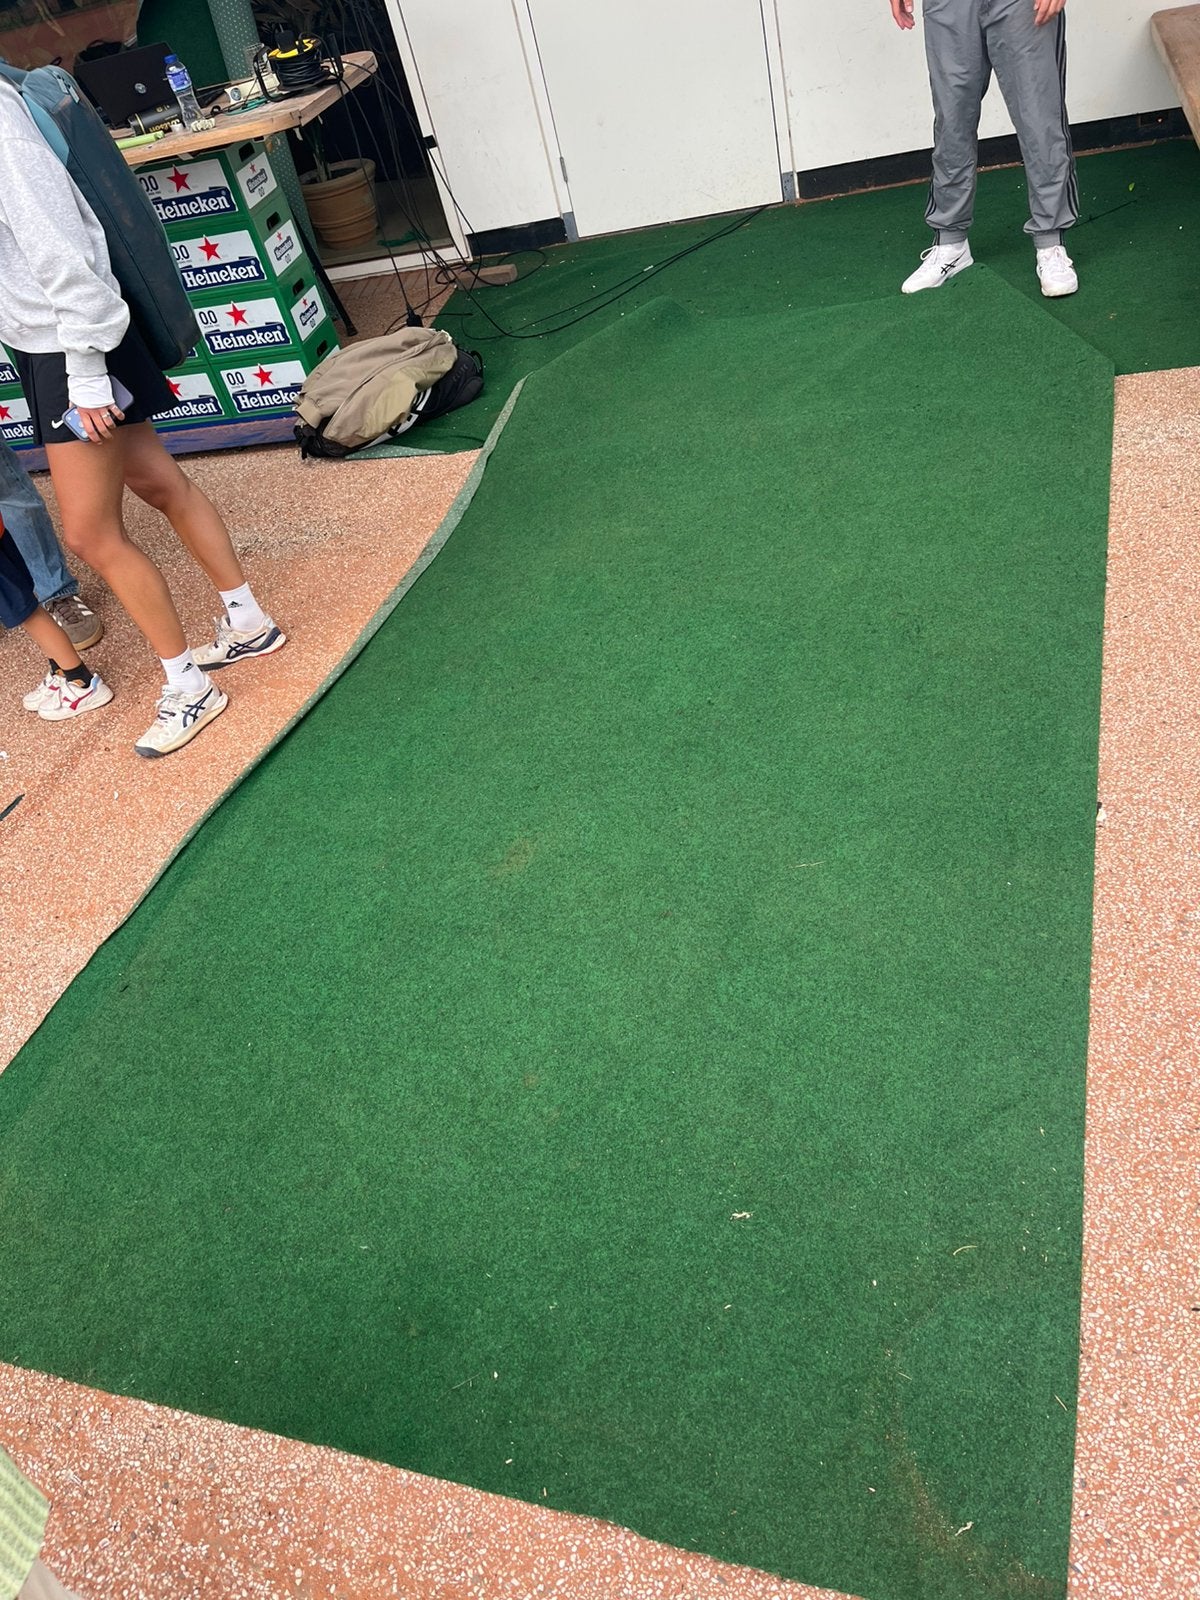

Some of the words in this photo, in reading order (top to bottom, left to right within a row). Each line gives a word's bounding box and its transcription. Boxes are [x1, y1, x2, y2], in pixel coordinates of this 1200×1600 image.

[154, 195, 230, 221] Heineken
[182, 264, 259, 288] Heineken
[199, 310, 218, 325] 0.0
[210, 329, 285, 350] Heineken
[226, 371, 245, 385] 0.0
[237, 391, 299, 409] Heineke
